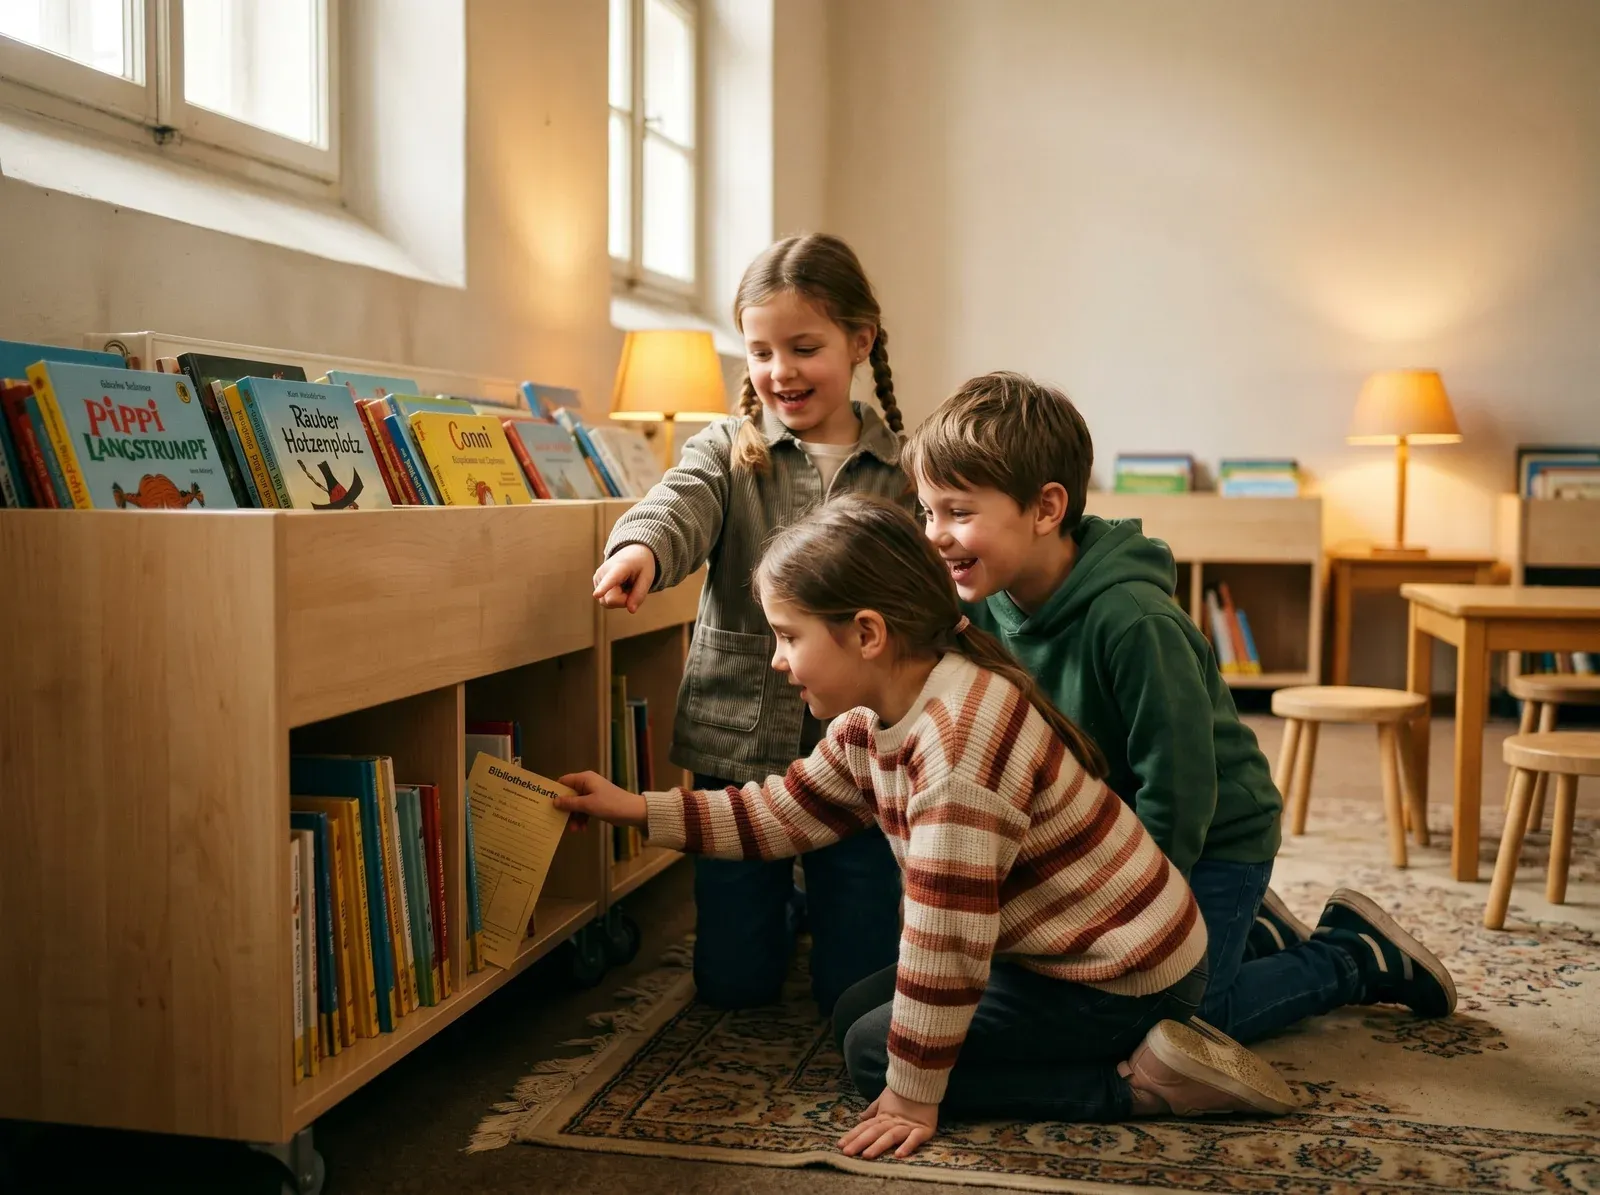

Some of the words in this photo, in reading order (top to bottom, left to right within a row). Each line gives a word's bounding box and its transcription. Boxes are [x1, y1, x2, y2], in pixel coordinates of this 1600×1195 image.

[83, 395, 166, 437] Pippi
[289, 404, 339, 430] Räuber
[82, 433, 207, 462] LANGSTRUMPF
[282, 427, 364, 460] Hotzenplotz
[449, 420, 493, 451] Conni
